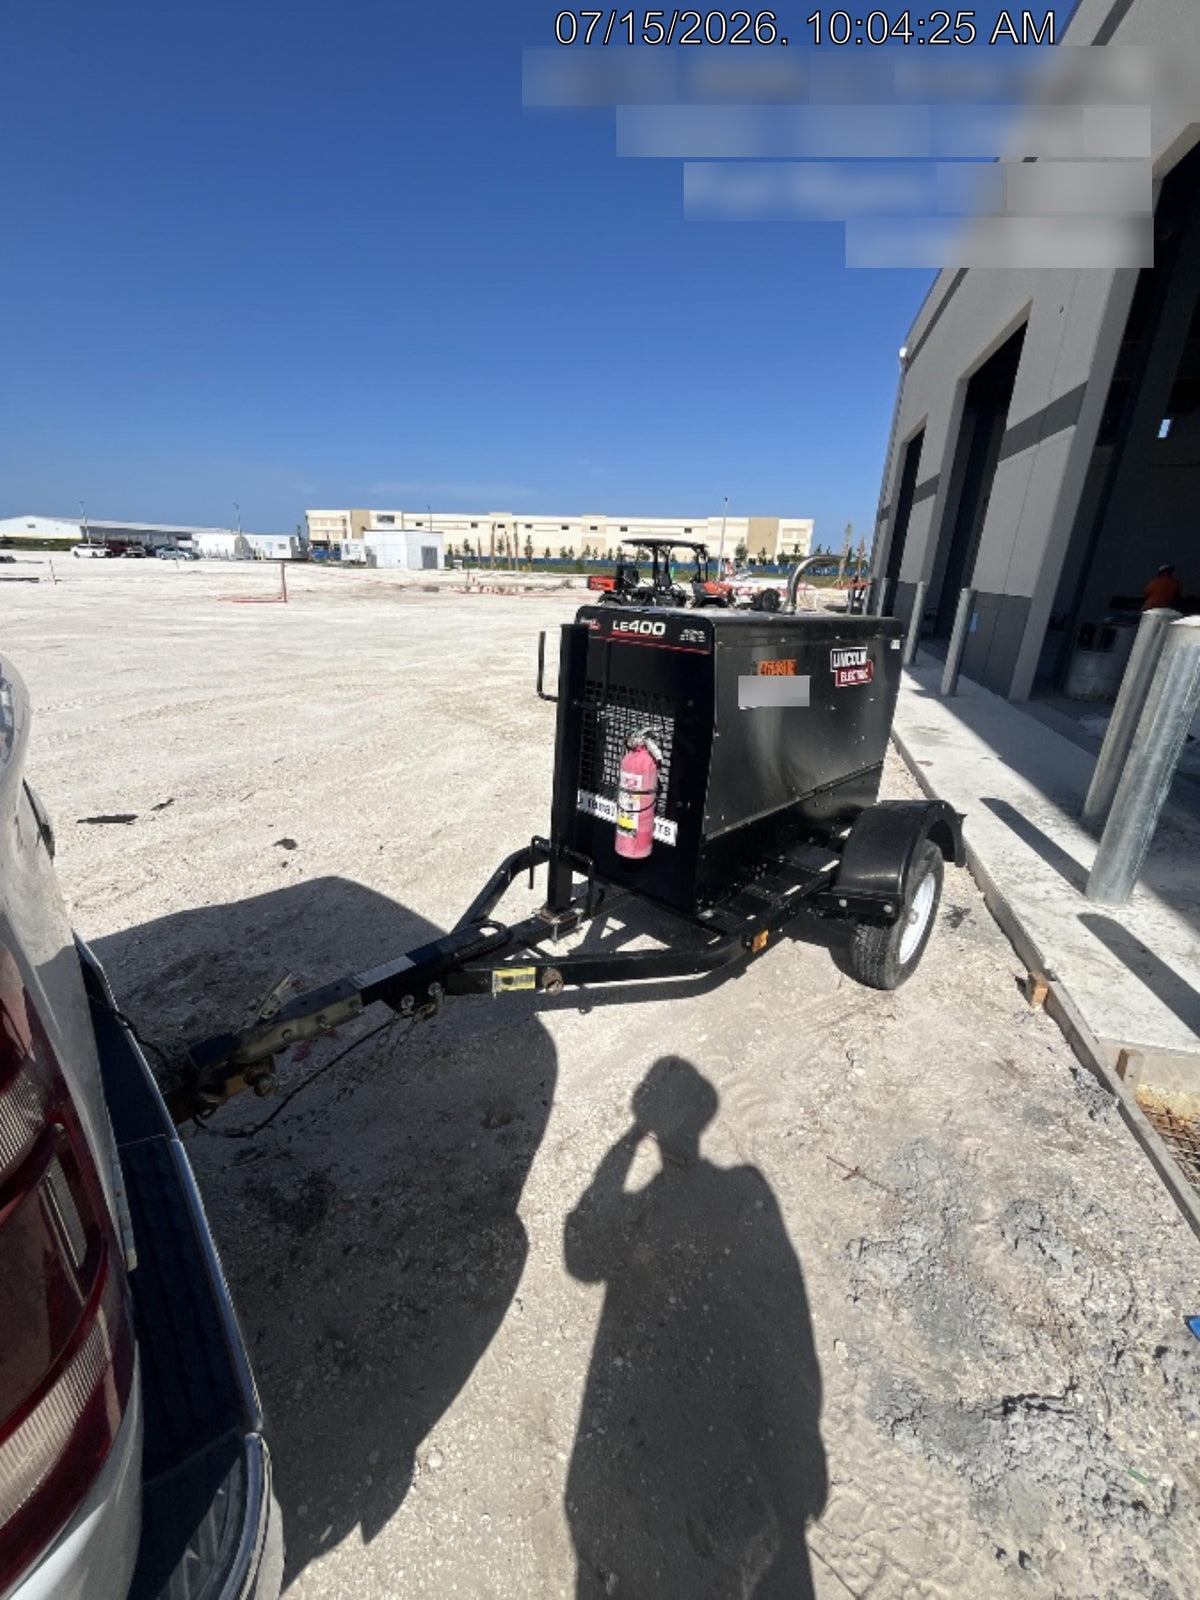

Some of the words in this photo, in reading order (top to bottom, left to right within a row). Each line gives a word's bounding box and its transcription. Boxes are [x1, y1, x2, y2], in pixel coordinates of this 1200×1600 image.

[612, 620, 666, 636] LE400
[833, 650, 867, 668] LINCOLN
[840, 668, 869, 683] ELECTRIC
